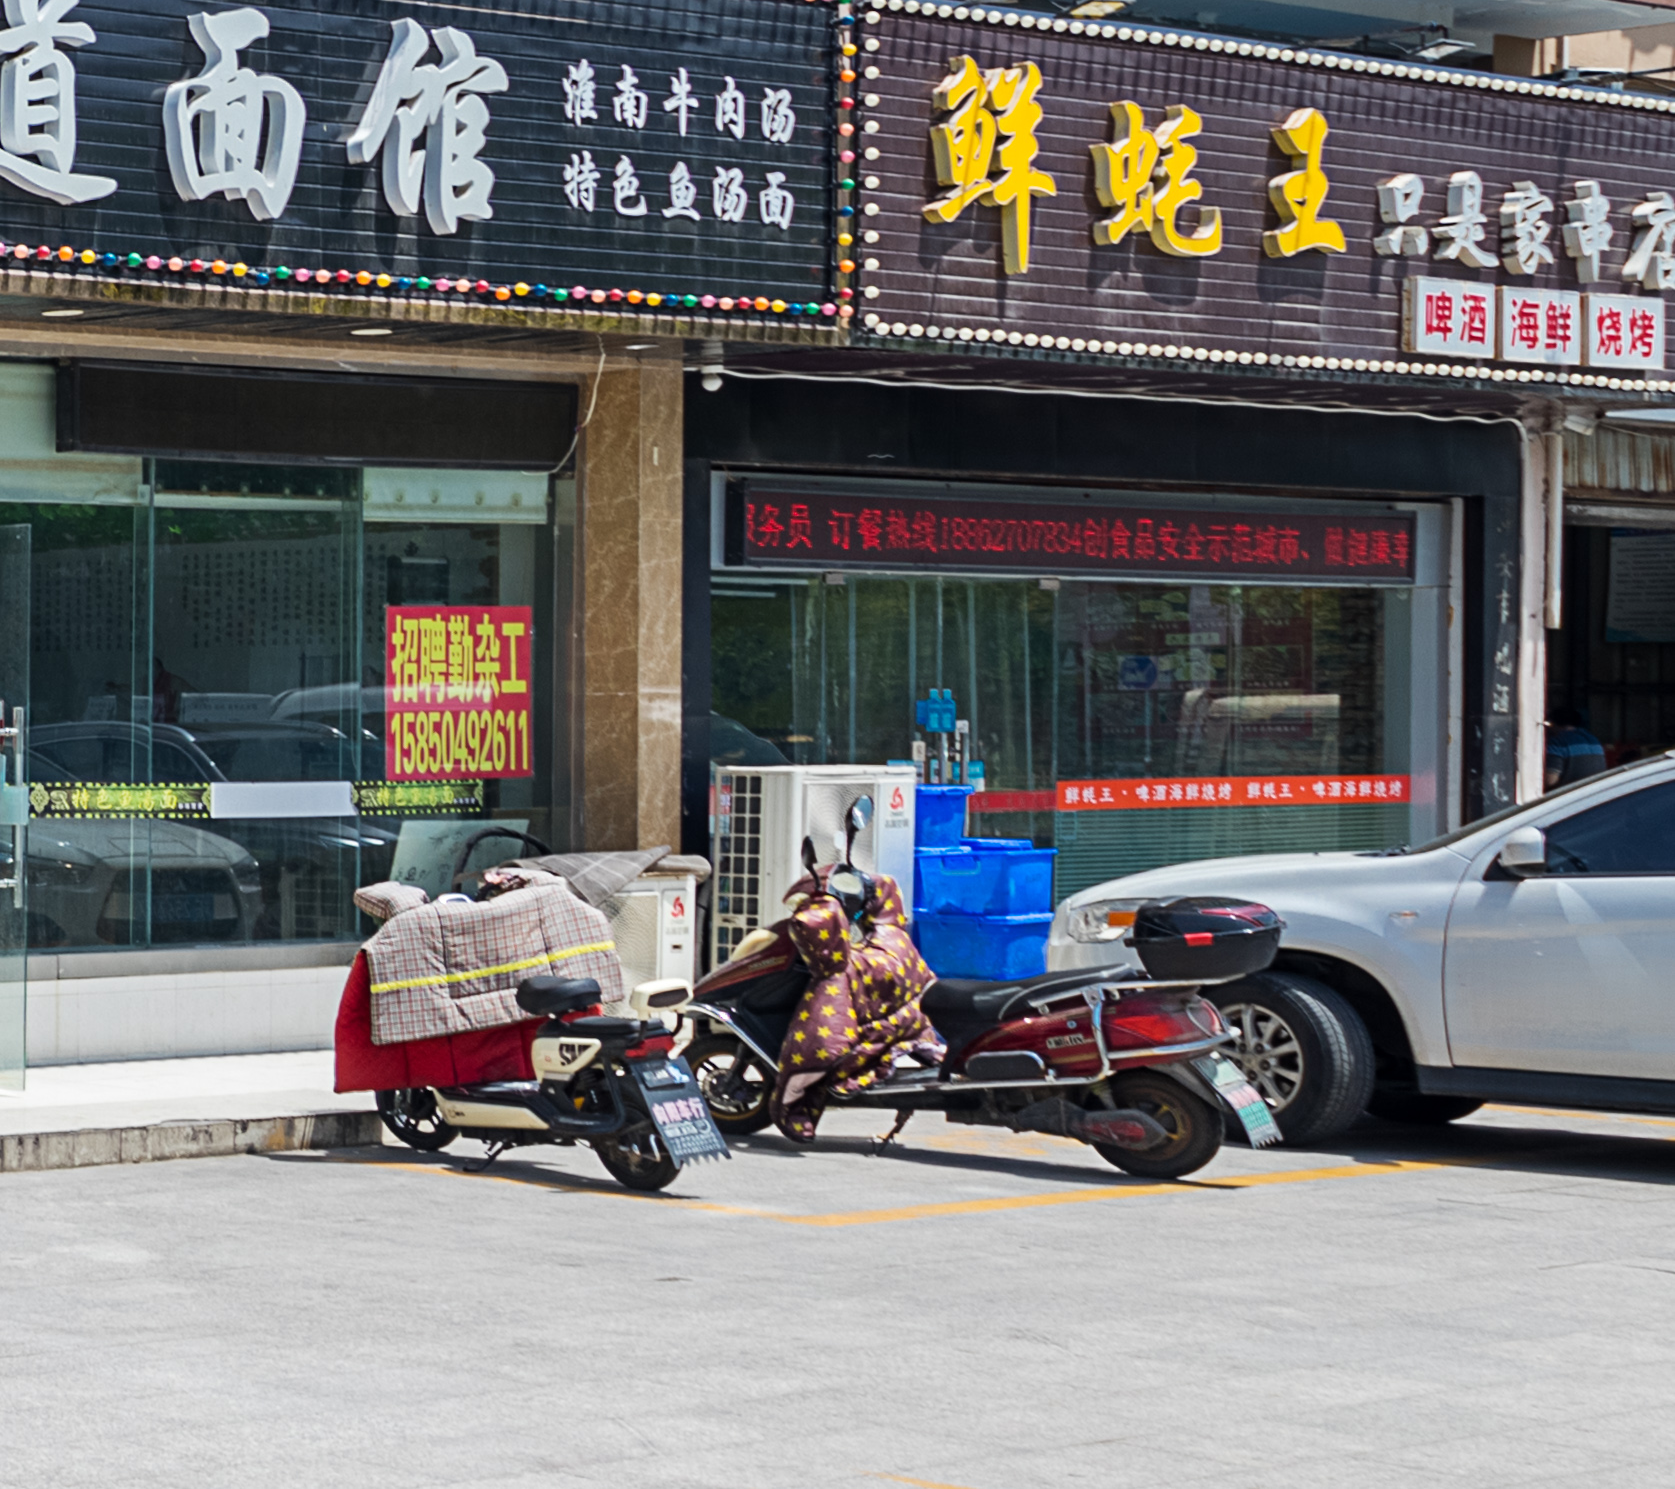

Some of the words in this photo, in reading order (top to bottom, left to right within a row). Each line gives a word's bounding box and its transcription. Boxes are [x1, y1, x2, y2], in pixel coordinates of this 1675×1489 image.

[562, 58, 796, 143] 淮南牛肉汤
[562, 150, 795, 230] 特色鱼汤面
[922, 55, 1346, 274] 鲜蚝王
[1425, 291, 1487, 345] 啤酒
[1511, 299, 1572, 353] 海鲜
[1596, 306, 1655, 358] 烧烤
[391, 613, 528, 704] 招聘勤杂工
[391, 709, 529, 775] 15850492611
